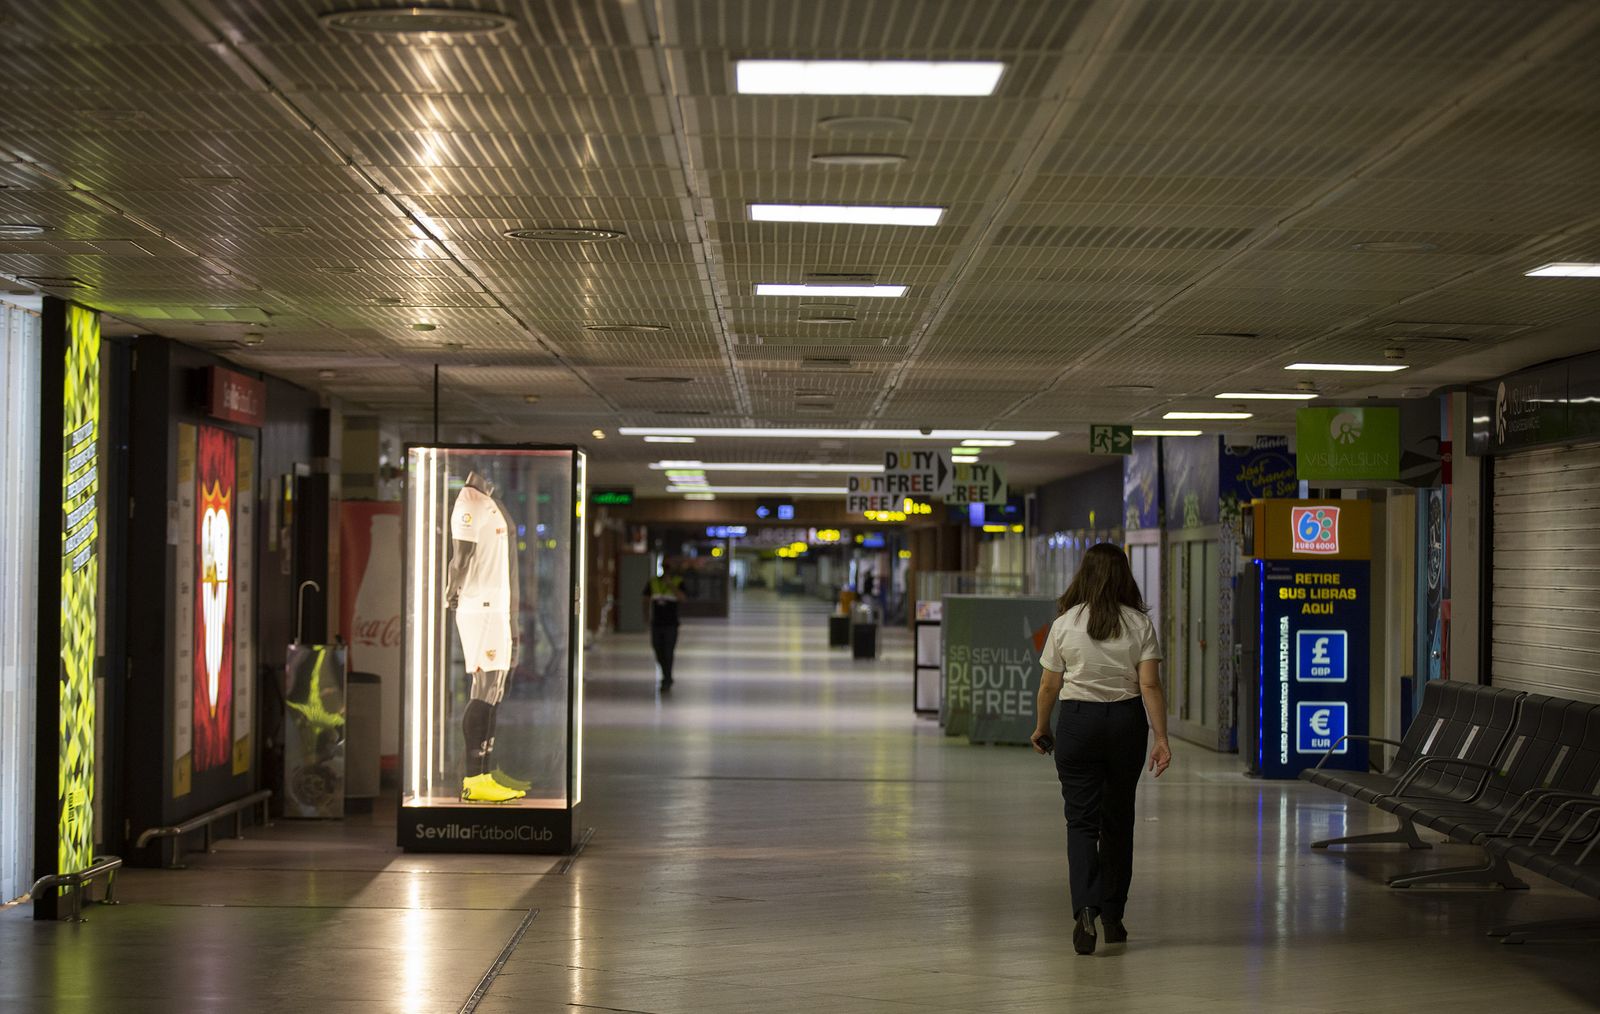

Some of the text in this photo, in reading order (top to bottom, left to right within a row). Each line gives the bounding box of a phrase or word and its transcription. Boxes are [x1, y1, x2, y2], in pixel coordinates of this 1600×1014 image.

[886, 452, 934, 470] DUTY
[1304, 452, 1391, 467] VISUALSUN
[850, 477, 884, 492] DUT
[887, 475, 934, 492] FREE
[850, 496, 889, 511] FREE
[1295, 573, 1341, 585] RETIRE
[1279, 587, 1357, 600] SUS LIBRAS
[1301, 601, 1334, 614] AQUÍ
[972, 648, 1033, 664] SEVILLA
[972, 665, 1032, 690] DUTY
[1311, 667, 1331, 676] GBP
[1280, 616, 1289, 764] CAJERO AUTOMÁTICO MULTI-DIVISA
[972, 689, 1033, 715] FREE
[1311, 738, 1331, 748] EUR
